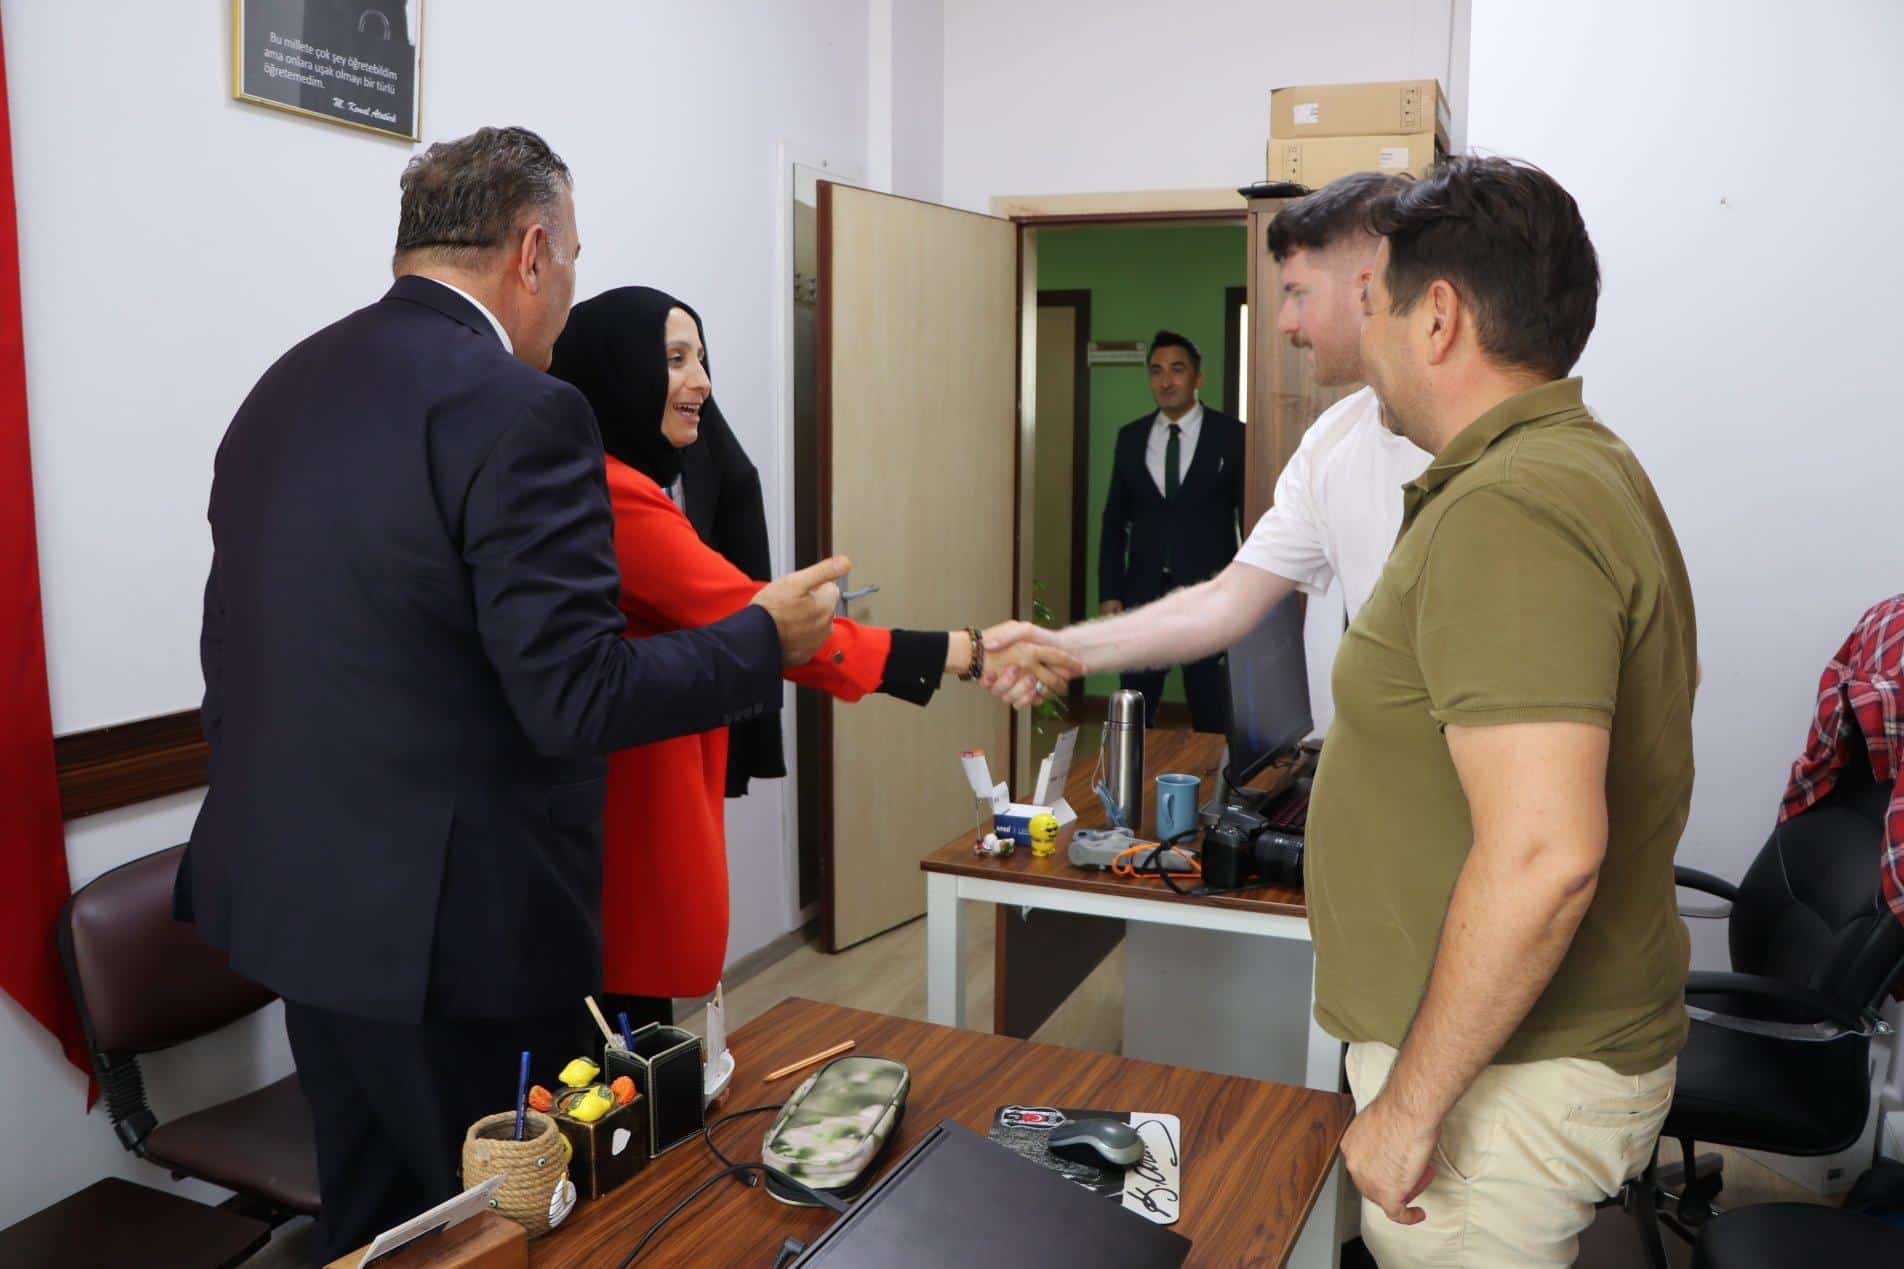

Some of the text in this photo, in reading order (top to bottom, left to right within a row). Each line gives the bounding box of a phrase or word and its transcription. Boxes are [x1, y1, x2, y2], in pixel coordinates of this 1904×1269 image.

[264, 48, 395, 95] ama onlara uşak olmayı bir türlü
[264, 63, 326, 89] öğretemedim.
[270, 32, 397, 80] Bu millete çok şey öğretebildim
